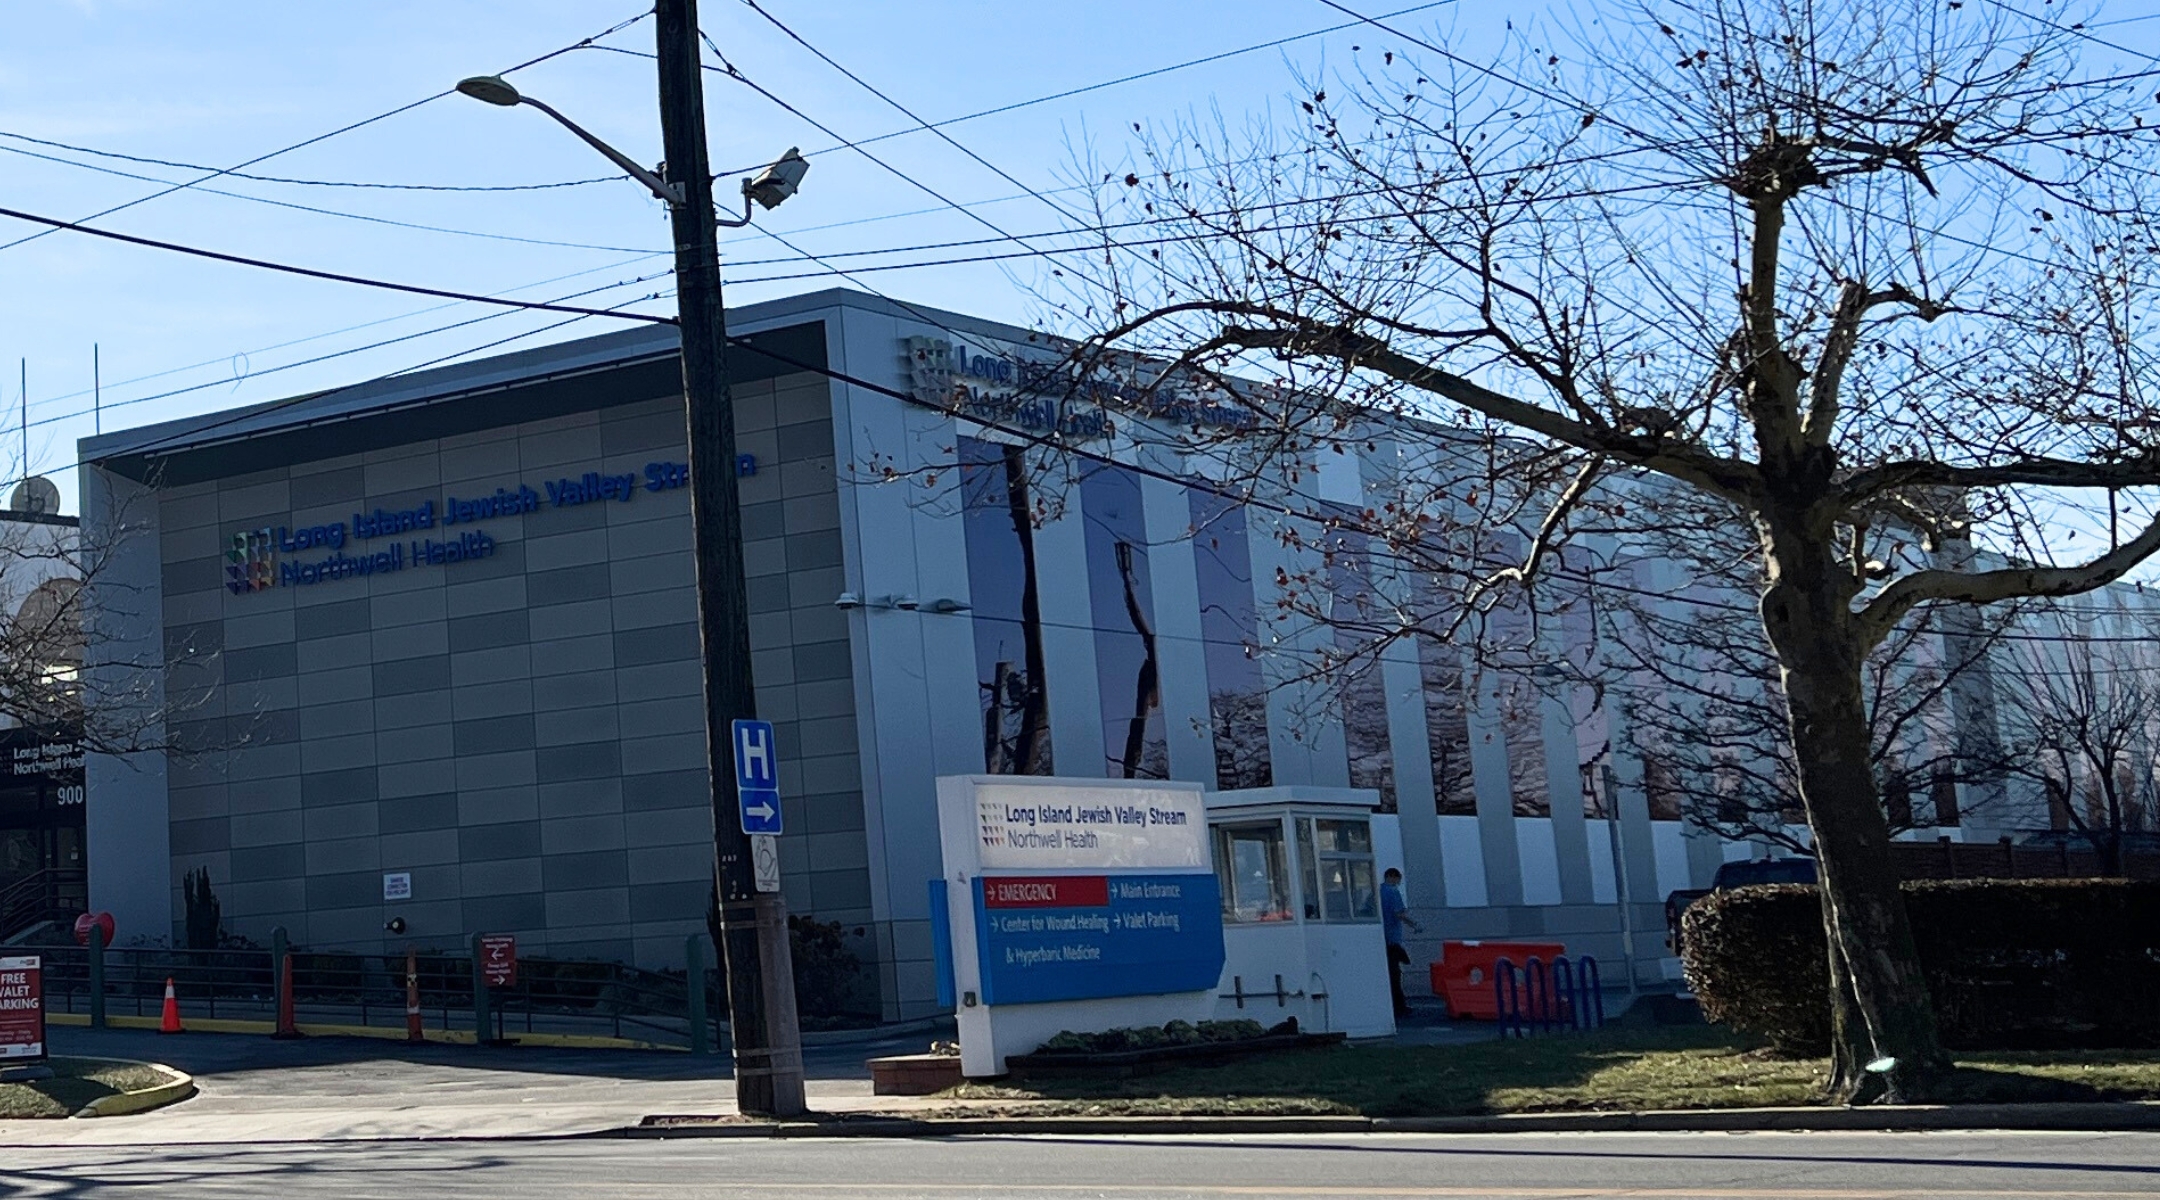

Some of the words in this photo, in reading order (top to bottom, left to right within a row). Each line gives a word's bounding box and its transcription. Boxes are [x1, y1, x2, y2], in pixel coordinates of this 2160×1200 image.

[278, 521, 345, 553] Long
[352, 500, 434, 539] Island
[442, 484, 538, 526] Jewish
[545, 472, 634, 507] Valley
[280, 543, 403, 587] Northwell
[412, 530, 495, 567] Health
[13, 747, 40, 760] Long
[741, 727, 770, 781] H
[57, 785, 84, 805] 900
[1006, 804, 1035, 826] Long
[1039, 804, 1073, 824] Island
[1075, 805, 1113, 825] Jewish
[1114, 806, 1147, 828] Valley
[1149, 807, 1188, 825] Stream
[1007, 829, 1063, 849] Northwell
[1065, 831, 1099, 849] Health
[998, 883, 1057, 902] EMERGENCY
[1120, 883, 1142, 899] Main
[1145, 882, 1181, 899] Entrance
[1001, 916, 1030, 933] Center
[1032, 915, 1045, 932] for
[1046, 914, 1076, 931] Wound
[1077, 913, 1110, 934] Healing
[1123, 912, 1146, 929] Valet
[1147, 911, 1181, 933] Parking
[1006, 947, 1015, 964] &
[1015, 946, 1062, 967] Hyperbaric
[1063, 945, 1100, 961] Medicine
[1, 972, 26, 985] FREE
[0, 997, 39, 1010] ARKING
